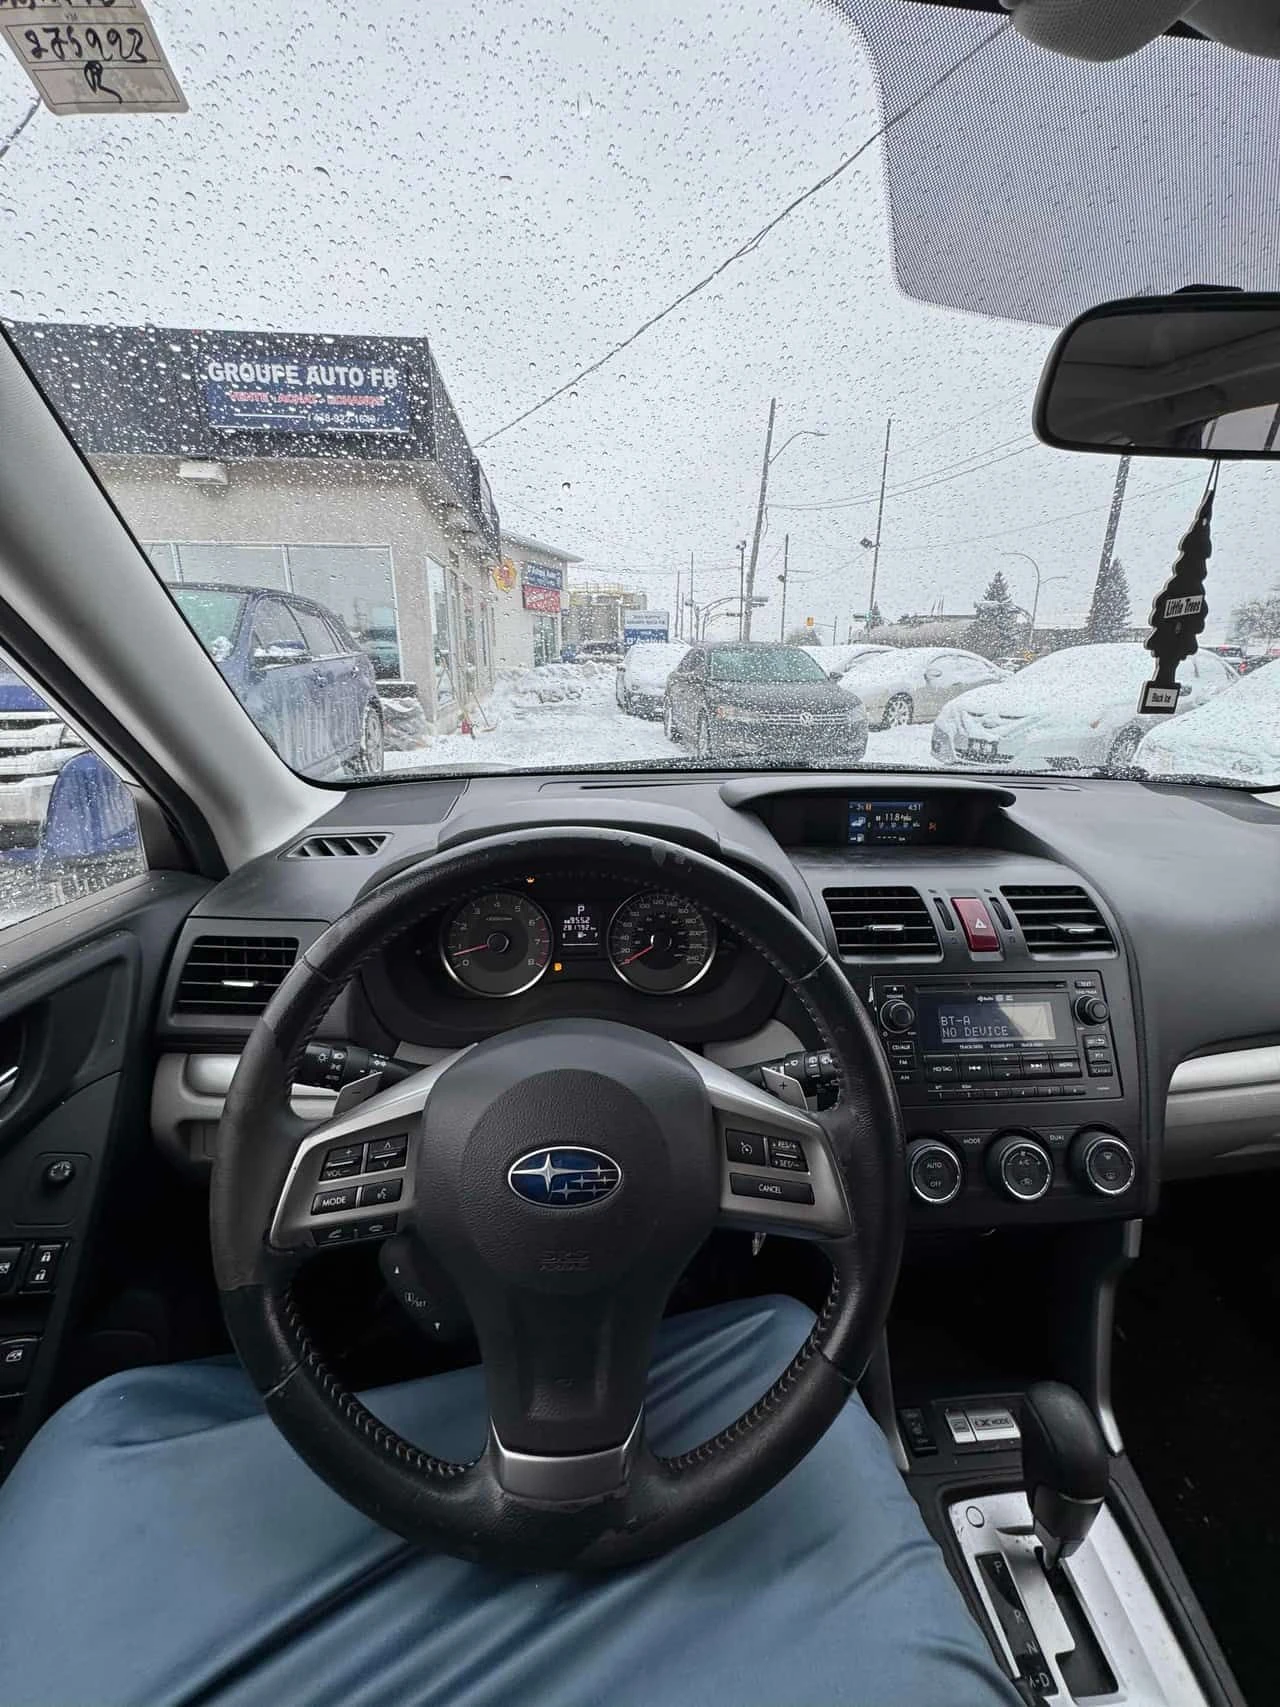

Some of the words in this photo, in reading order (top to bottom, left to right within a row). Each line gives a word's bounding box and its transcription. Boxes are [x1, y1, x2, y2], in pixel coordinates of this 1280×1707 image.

[306, 366, 365, 387] AUTO
[370, 367, 398, 388] FB
[1183, 598, 1200, 613] Trees
[577, 905, 585, 915] P
[940, 1015, 971, 1026] BT-A
[942, 1026, 958, 1037] NO
[964, 1026, 1009, 1037] DEVICE
[926, 1161, 943, 1169] AUTO
[758, 1183, 783, 1195] CANCEL
[930, 1180, 942, 1188] OFF
[322, 1195, 347, 1207] MODE
[993, 1560, 1002, 1574] P
[1013, 1608, 1025, 1624] R
[1026, 1641, 1039, 1656] N
